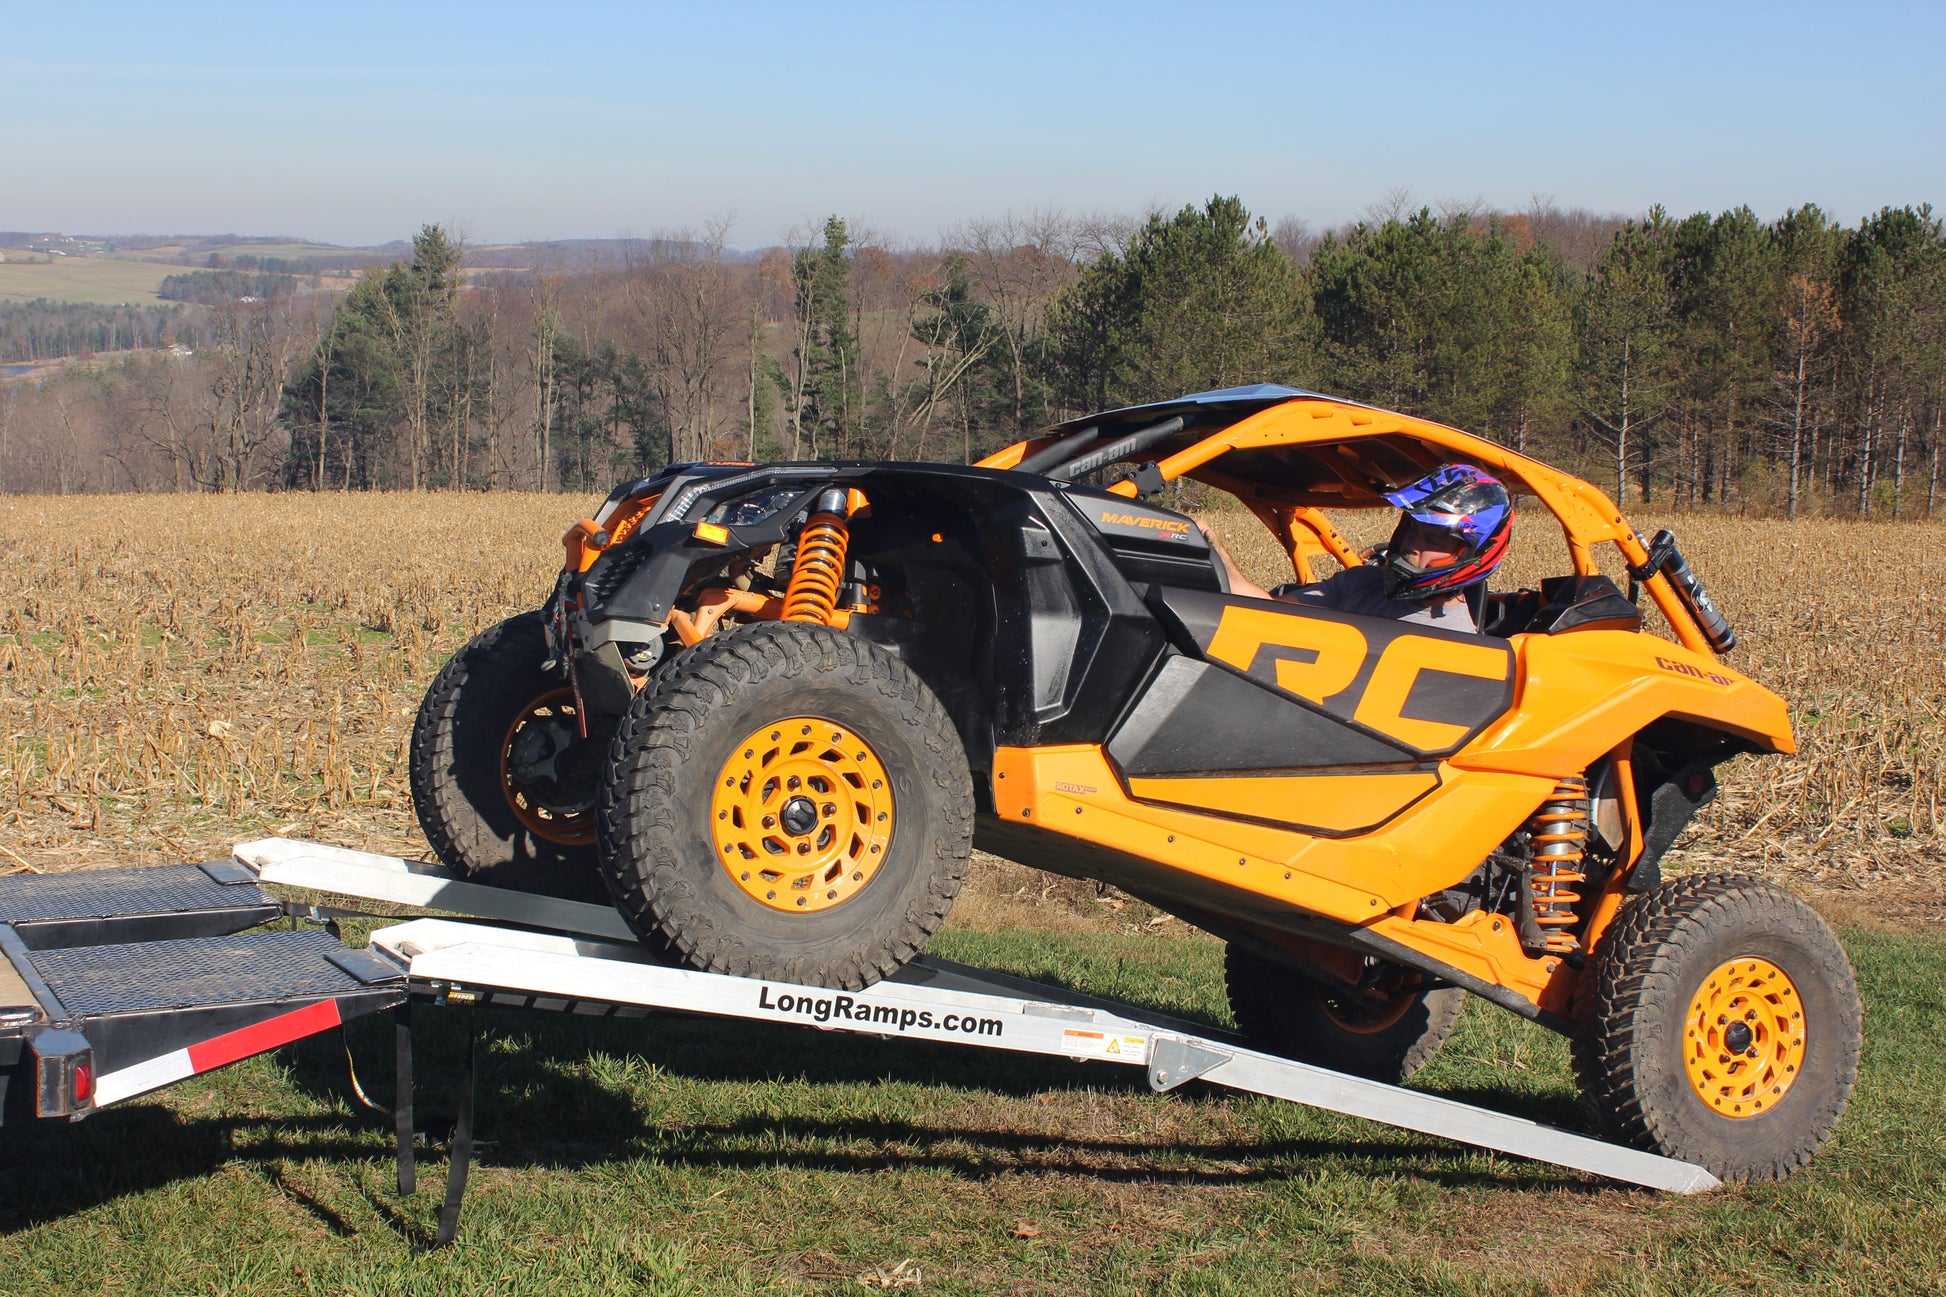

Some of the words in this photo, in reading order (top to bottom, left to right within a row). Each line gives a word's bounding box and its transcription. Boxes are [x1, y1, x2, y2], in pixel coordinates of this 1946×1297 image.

[1069, 438, 1136, 477] can-am
[1101, 512, 1191, 533] MAVERICK
[1206, 605, 1508, 751] RC
[1056, 782, 1085, 793] ROTAX
[758, 986, 1003, 1036] LongRamps.com
